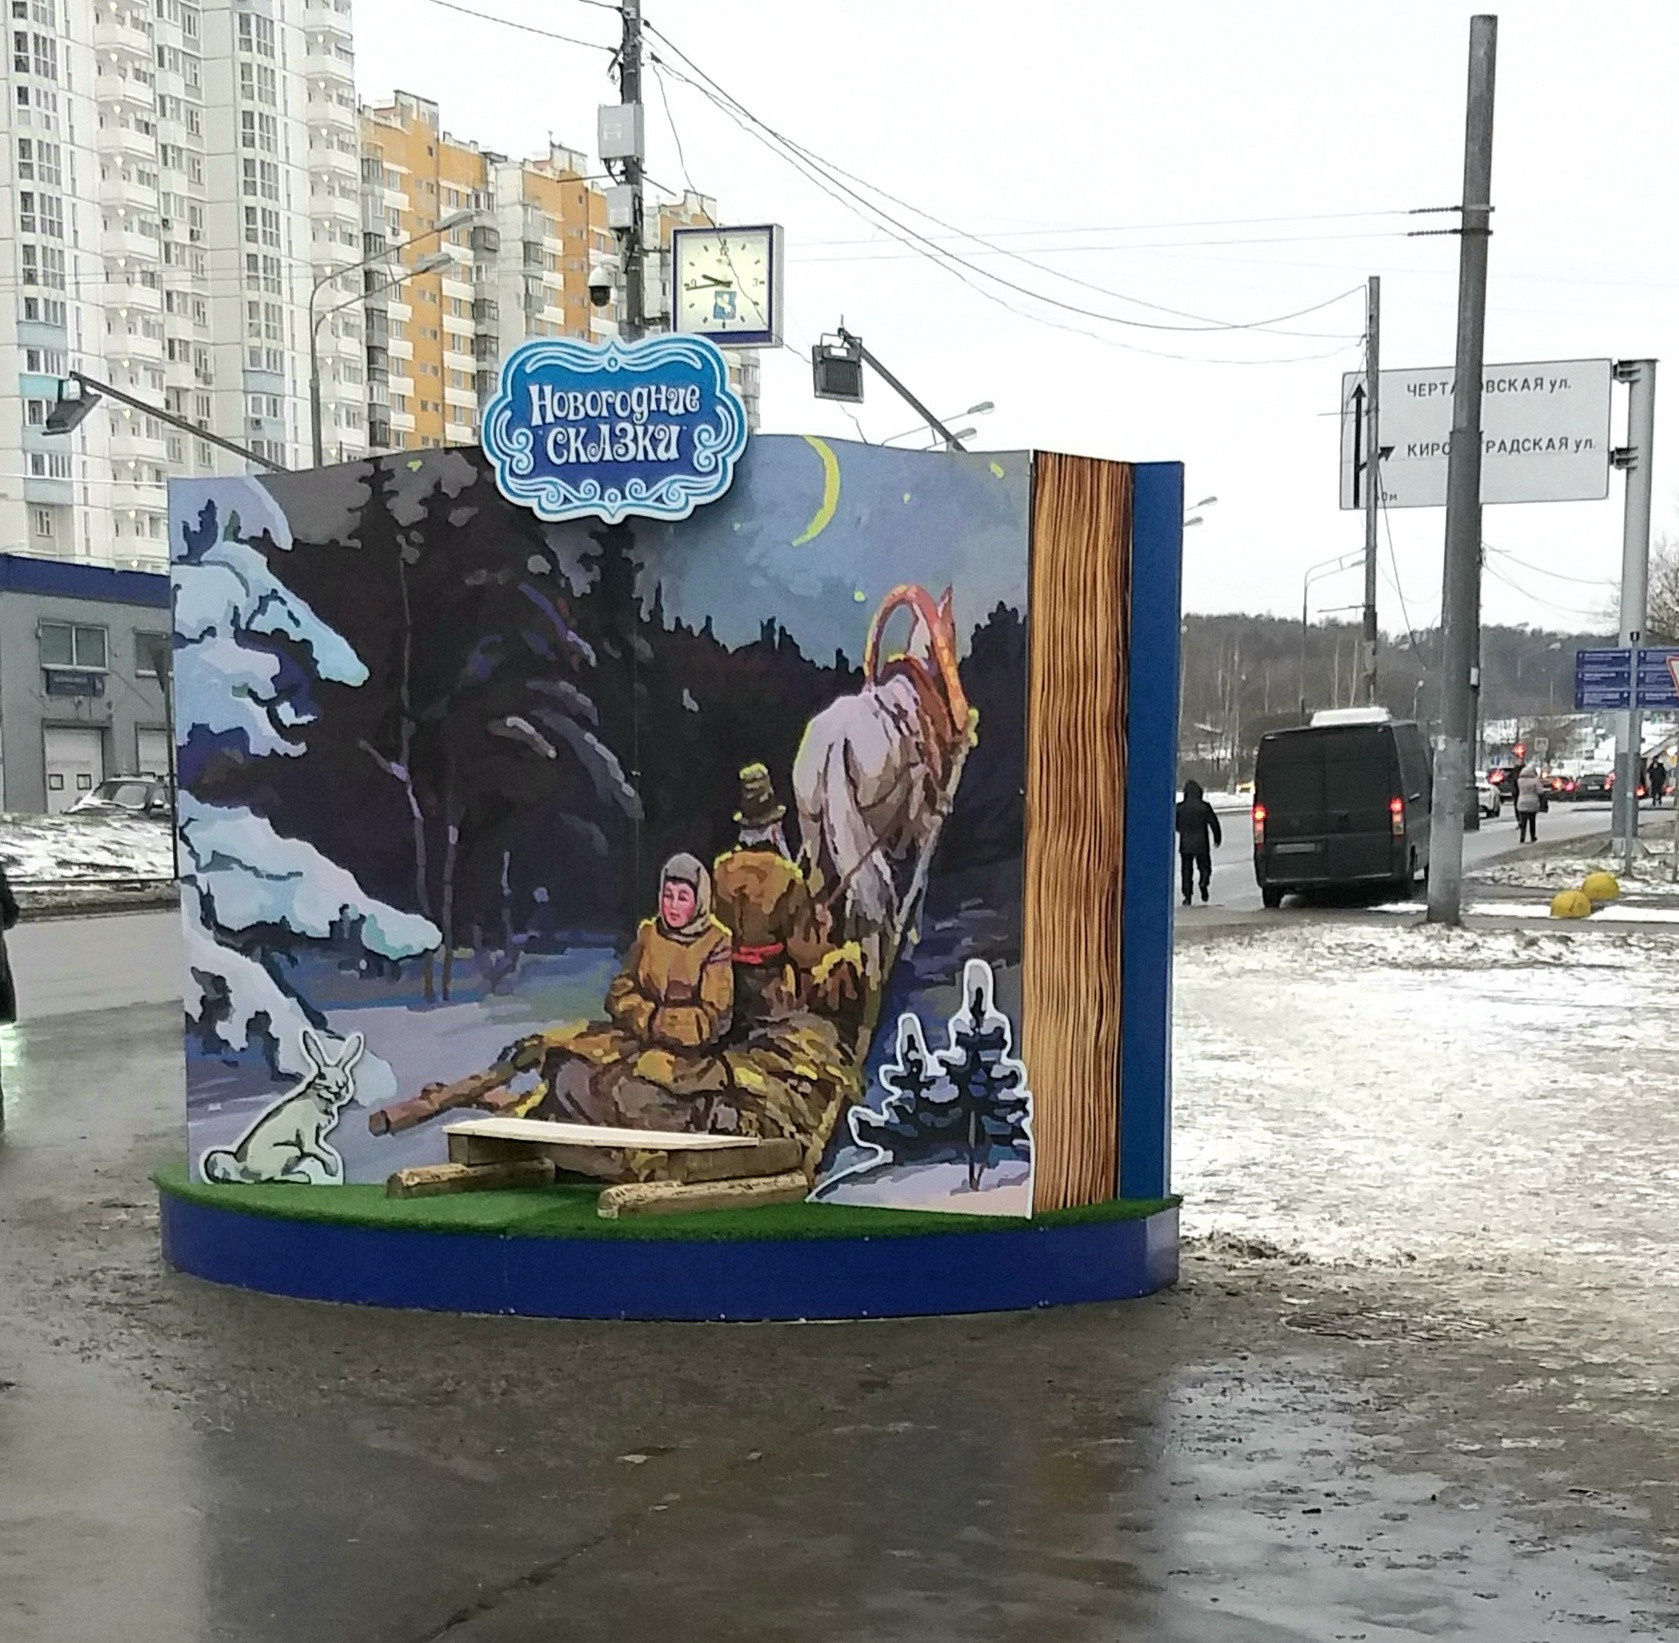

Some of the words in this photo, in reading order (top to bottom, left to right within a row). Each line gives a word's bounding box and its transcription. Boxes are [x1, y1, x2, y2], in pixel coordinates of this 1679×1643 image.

[1407, 376, 1544, 397] ЧЕРТВСКАЯ
[1549, 378, 1571, 394] ул.
[529, 384, 701, 427] Новогодние
[1407, 436, 1569, 457] КИРОРАДСКАЯ
[1574, 438, 1596, 454] ул.
